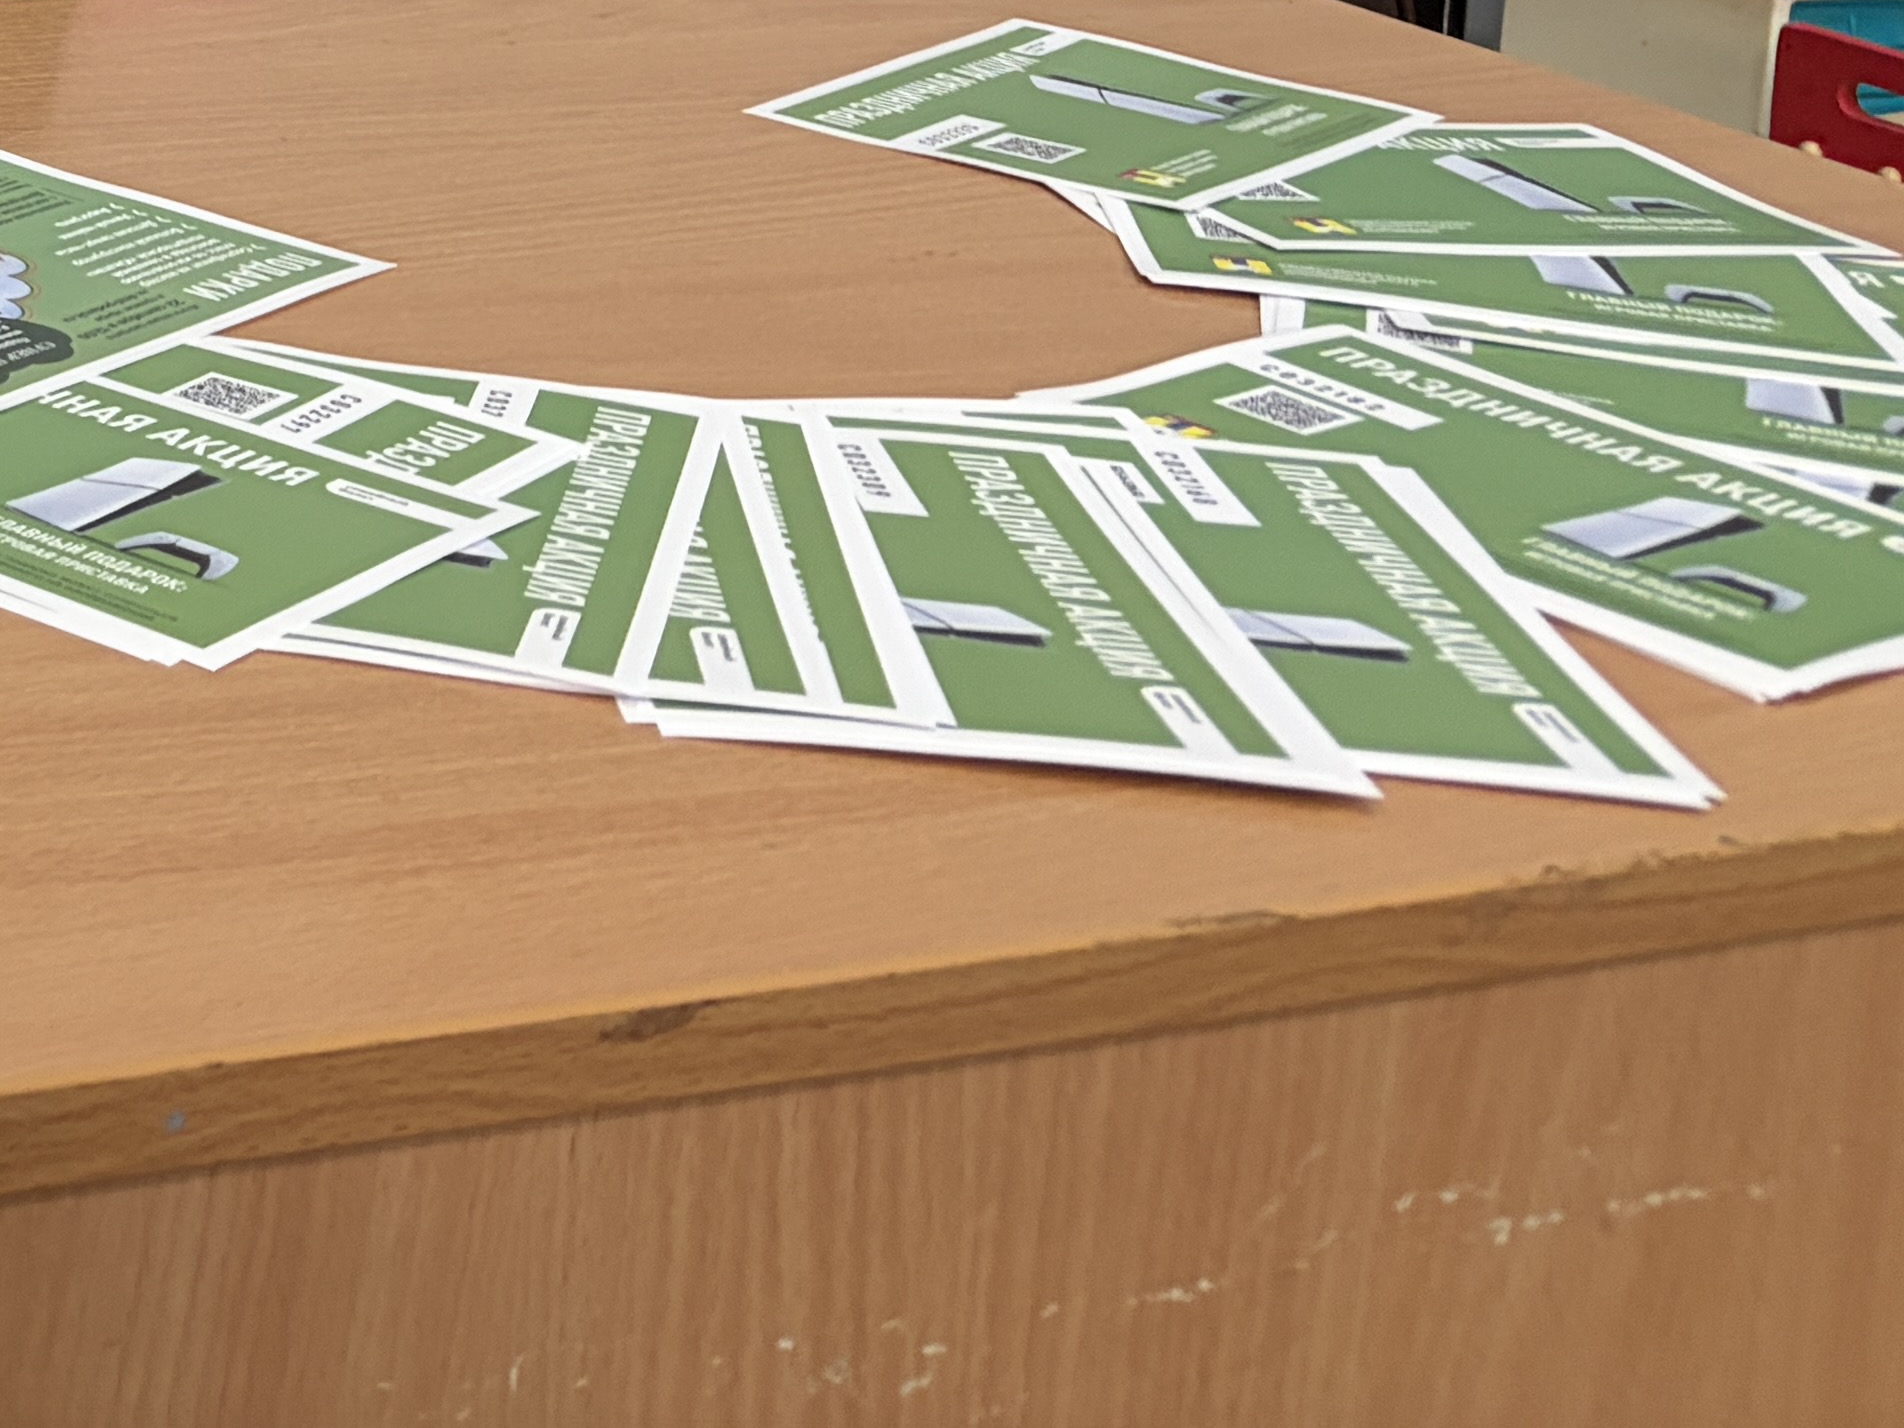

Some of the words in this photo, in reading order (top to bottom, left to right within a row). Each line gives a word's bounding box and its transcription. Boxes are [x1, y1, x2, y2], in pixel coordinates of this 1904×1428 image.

[183, 251, 324, 303] ПОДАРКИ
[147, 427, 320, 486] АКЦИЯ
[552, 406, 652, 540] ПРАЗДНИЧНАЯ
[1319, 345, 1684, 475] ПРАЗДНИЧНАЯ
[1676, 472, 1873, 541] АКЦИЯ
[522, 534, 605, 607] АКЦИЯ
[947, 450, 1112, 606] ПРАЗДНИЧНАЯ
[1058, 600, 1174, 683] АКЦИЯ
